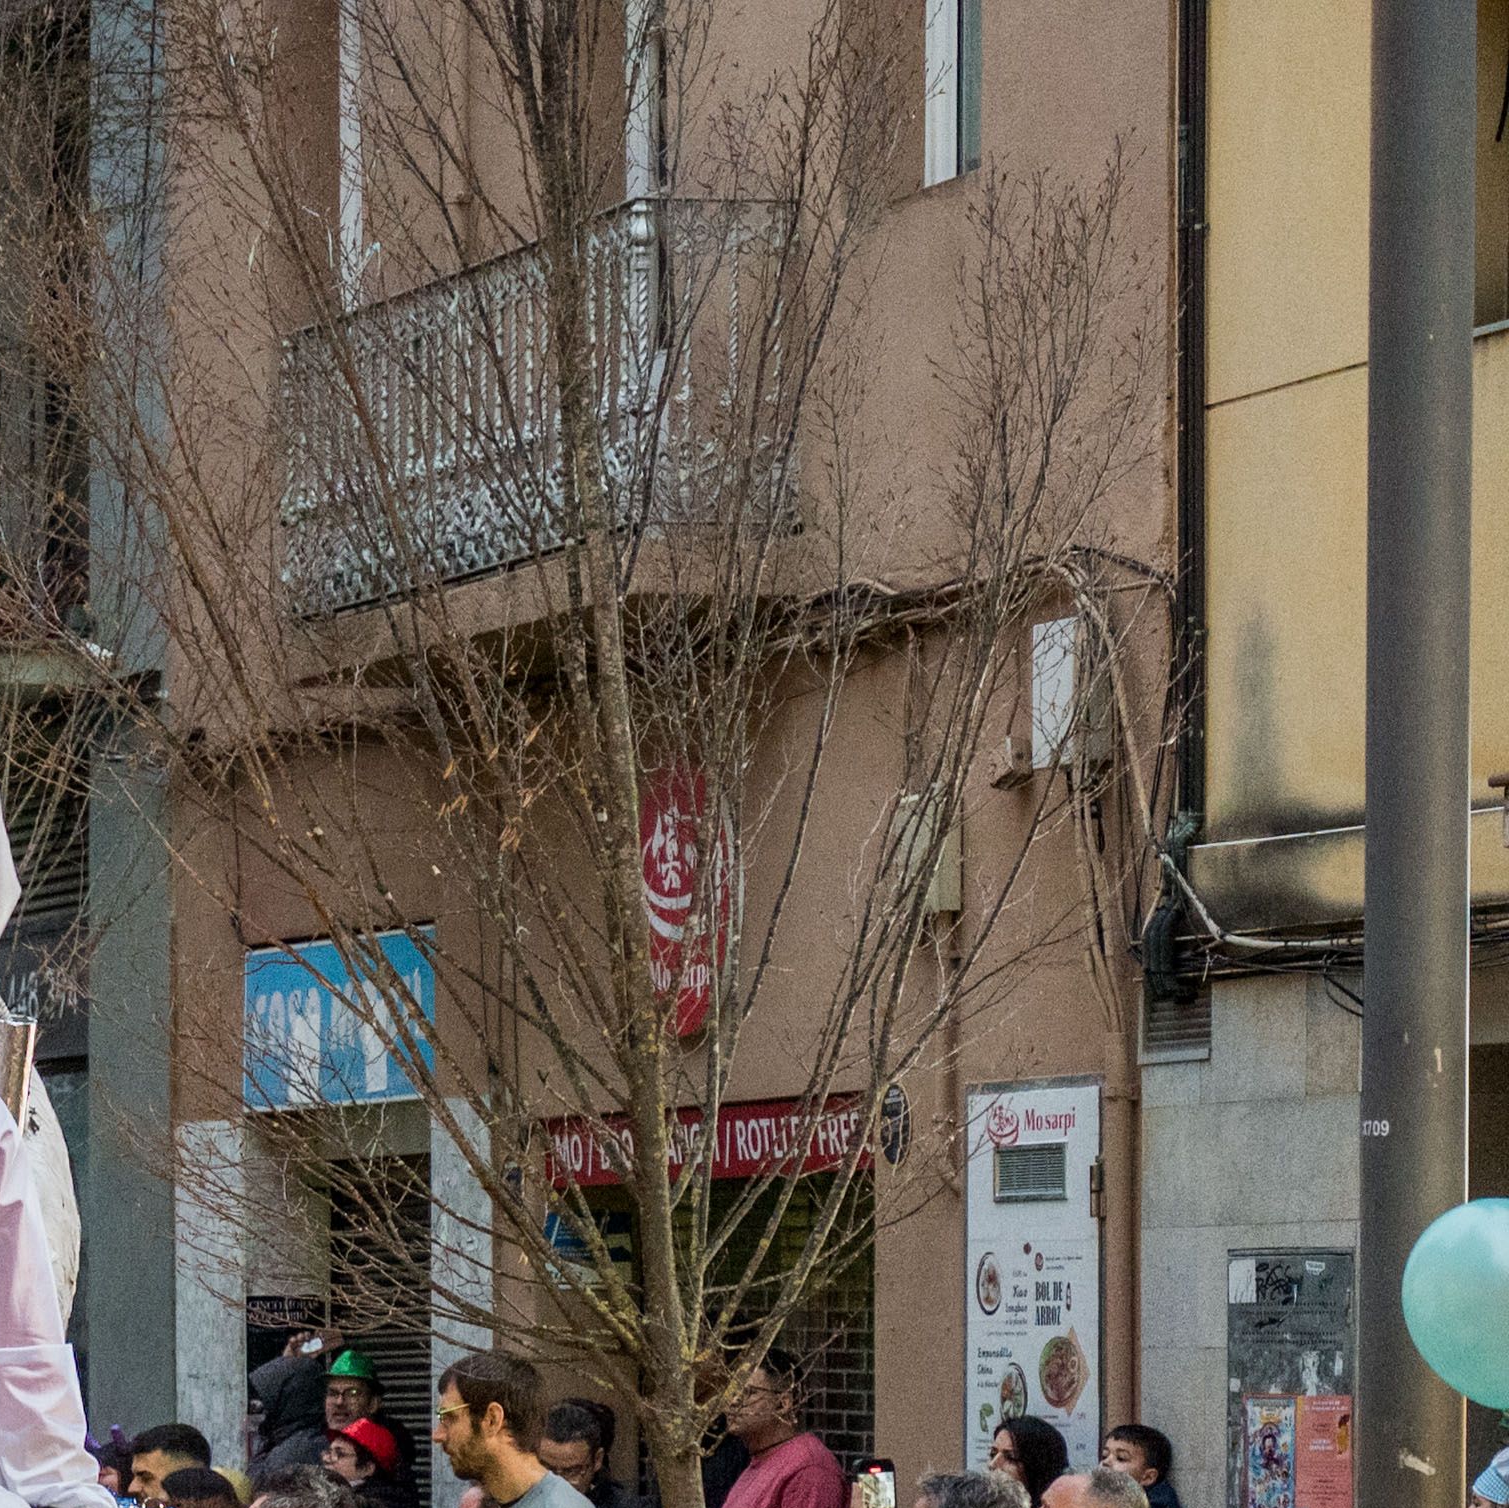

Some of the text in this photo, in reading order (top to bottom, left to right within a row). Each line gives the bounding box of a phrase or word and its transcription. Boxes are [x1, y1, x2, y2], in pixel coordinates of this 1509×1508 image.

[1024, 1106, 1076, 1136] Mosarpi
[1035, 1281, 1063, 1301] BOL DE
[1034, 1305, 1061, 1326] ARROZ
